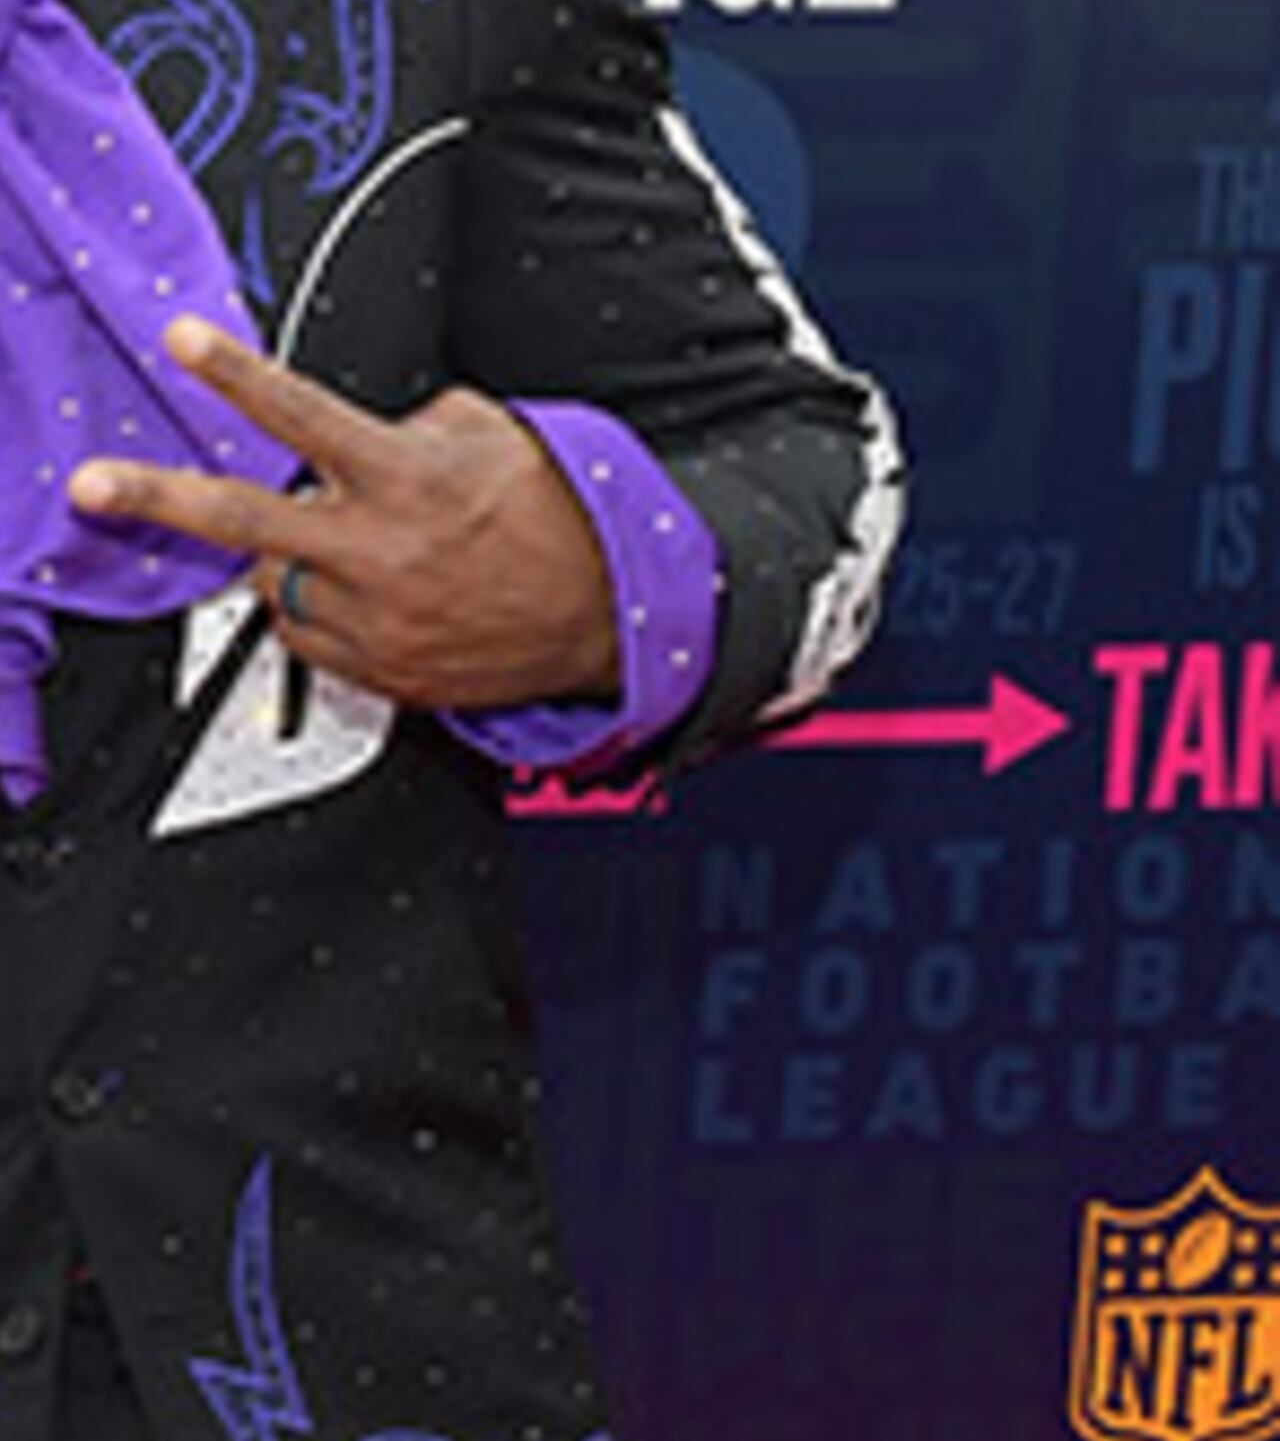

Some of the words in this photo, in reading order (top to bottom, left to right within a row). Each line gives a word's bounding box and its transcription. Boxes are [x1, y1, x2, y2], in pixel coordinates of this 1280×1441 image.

[1132, 262, 1280, 473] PI
[1195, 481, 1263, 591] IS
[702, 934, 1280, 1037] FOOTBA
[692, 1041, 1230, 1142] LEAGUE
[1105, 1311, 1276, 1429] NFL
